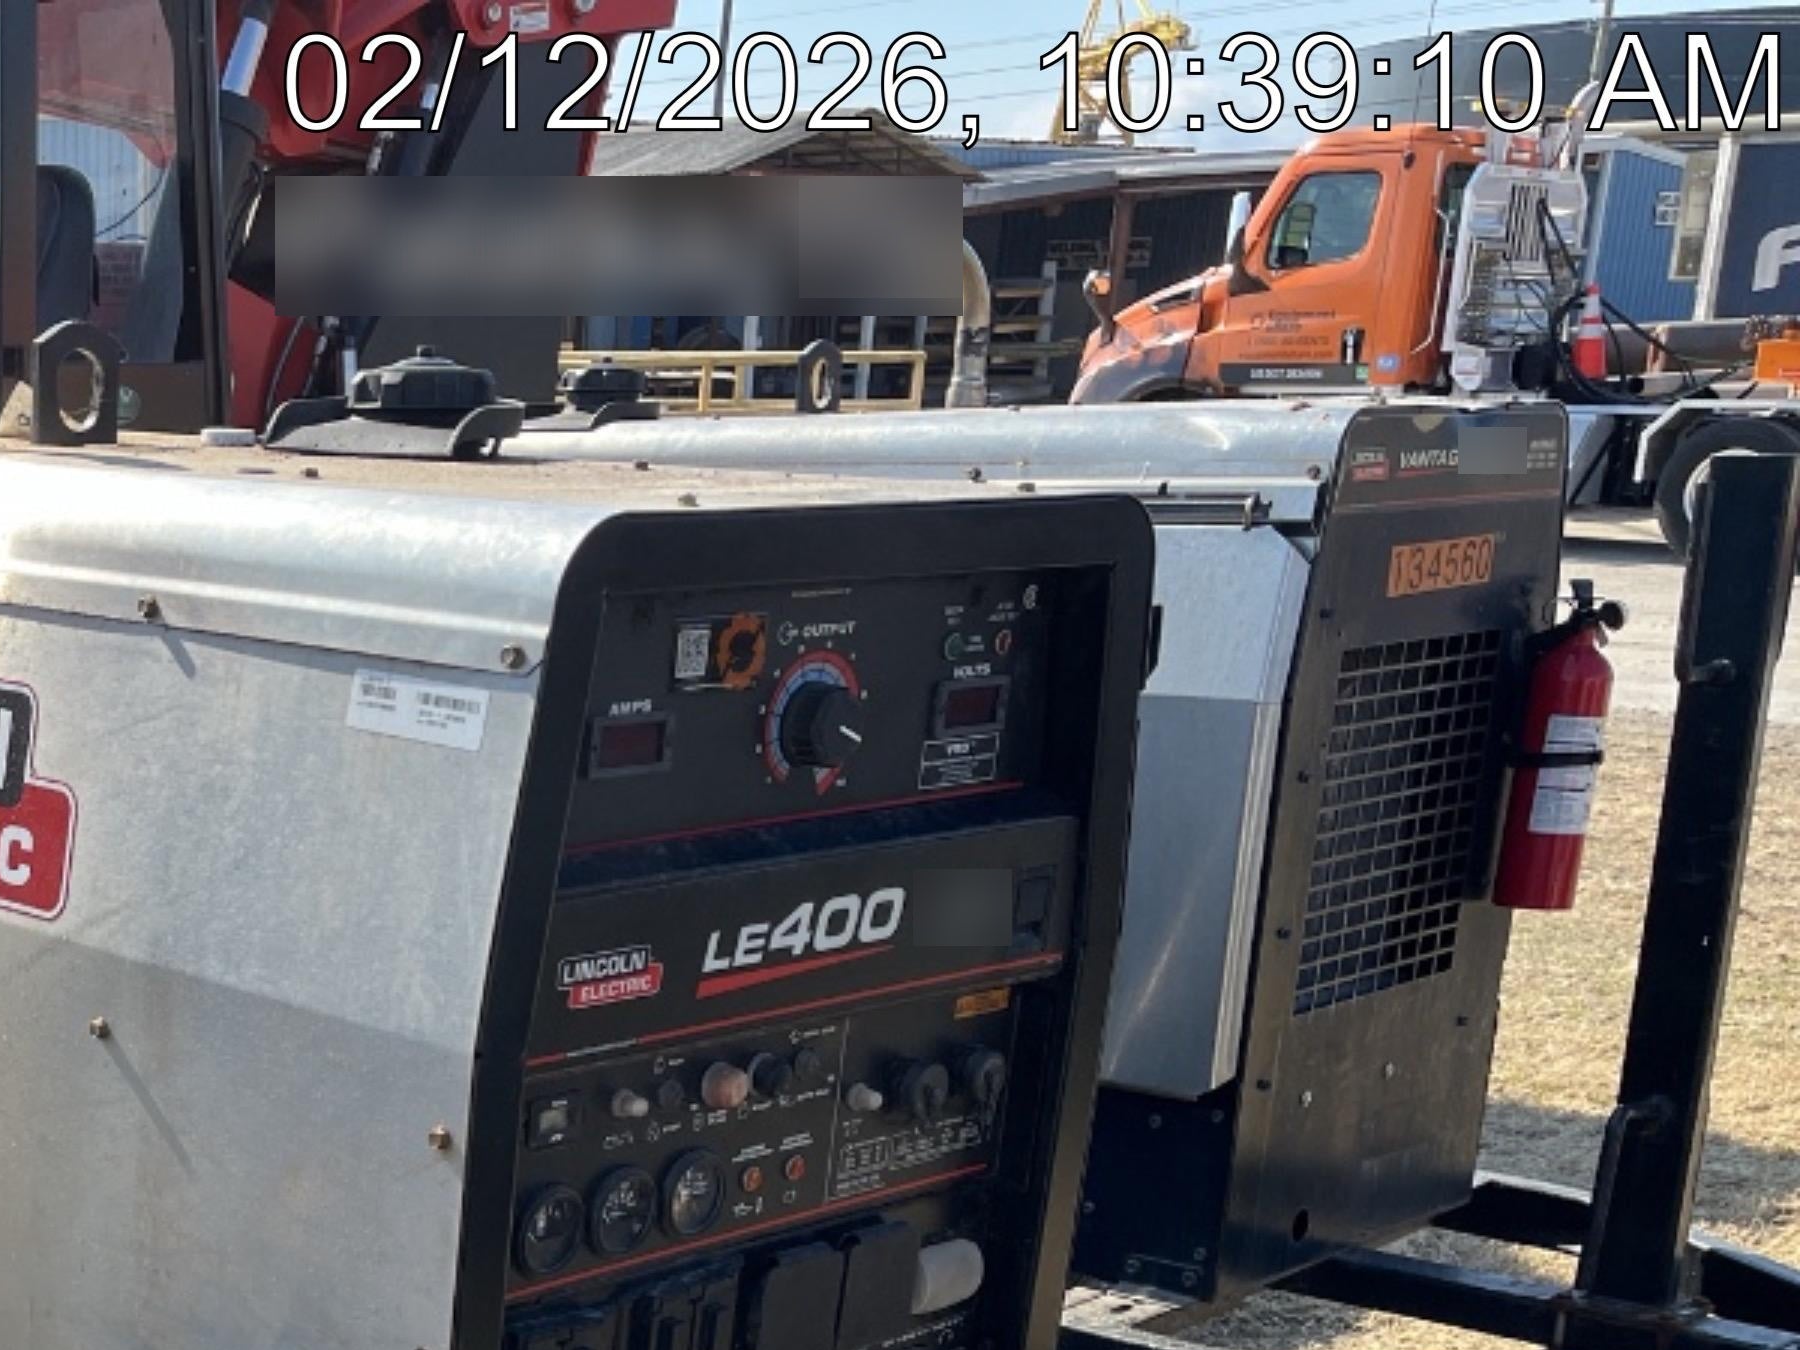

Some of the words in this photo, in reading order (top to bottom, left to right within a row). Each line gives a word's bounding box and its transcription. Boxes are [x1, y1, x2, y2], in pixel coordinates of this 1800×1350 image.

[802, 620, 857, 638] OUTPUT
[608, 698, 653, 718] AMPS
[701, 887, 907, 974] LE400
[562, 950, 649, 984] LINCOLN
[580, 973, 652, 1002] ELECTRIC
